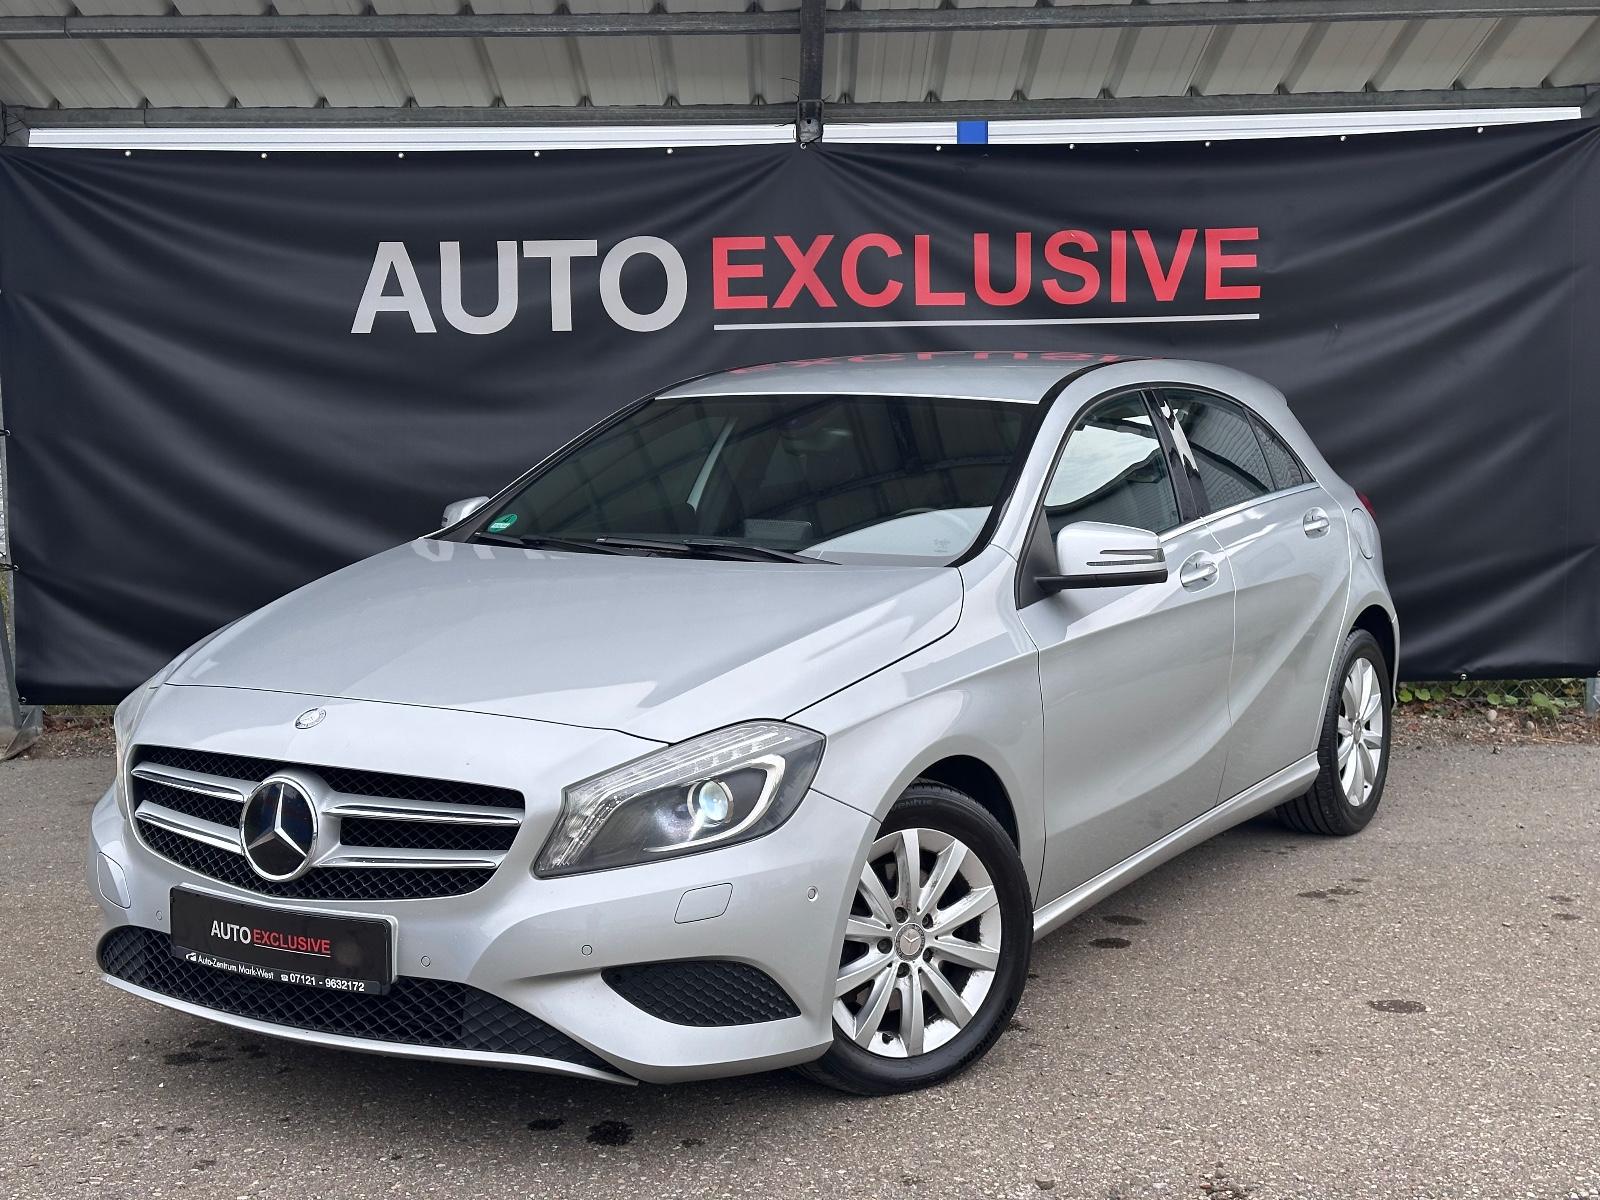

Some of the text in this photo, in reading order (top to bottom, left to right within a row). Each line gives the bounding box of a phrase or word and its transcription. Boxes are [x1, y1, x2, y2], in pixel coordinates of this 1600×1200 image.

[350, 227, 1261, 335] AUTO EXCLUSIVE
[210, 920, 332, 954] AUTO EXCLUSIVE
[197, 954, 238, 973] Auto-Zentrum
[238, 963, 275, 980] Mark-West
[289, 973, 316, 986] 07121
[324, 977, 366, 992] 9632172
